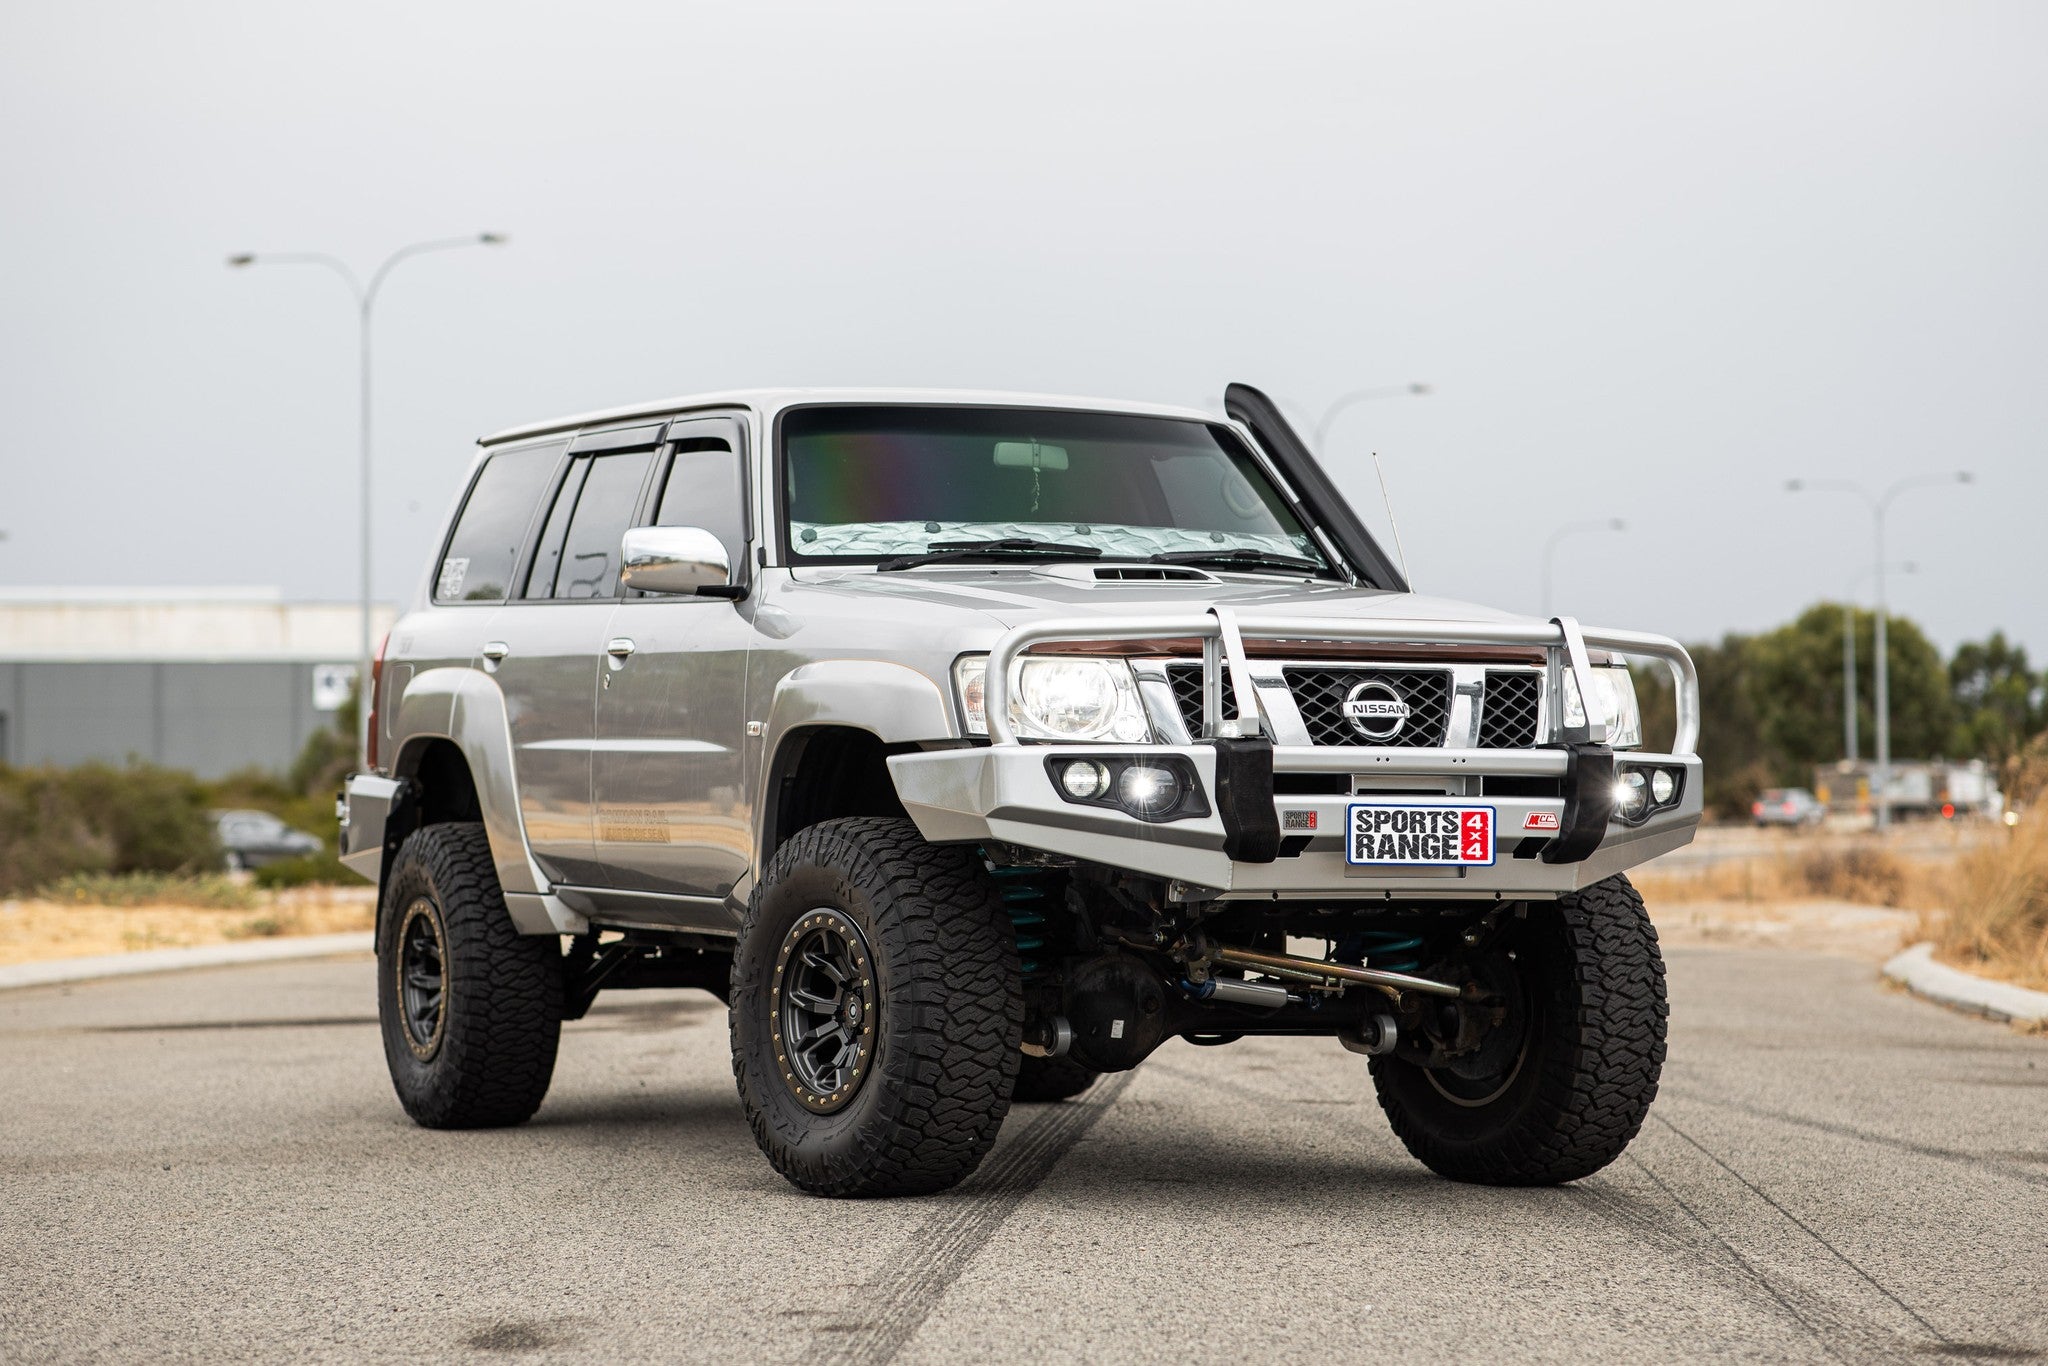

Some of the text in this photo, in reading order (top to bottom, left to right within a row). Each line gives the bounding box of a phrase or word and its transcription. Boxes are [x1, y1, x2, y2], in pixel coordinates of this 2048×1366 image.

[1352, 704, 1405, 714] NISSAN
[1285, 811, 1309, 820] SPORTS
[1285, 820, 1309, 828] RANGE
[1356, 810, 1459, 834] SPORTS
[1356, 834, 1459, 860] RANGE
